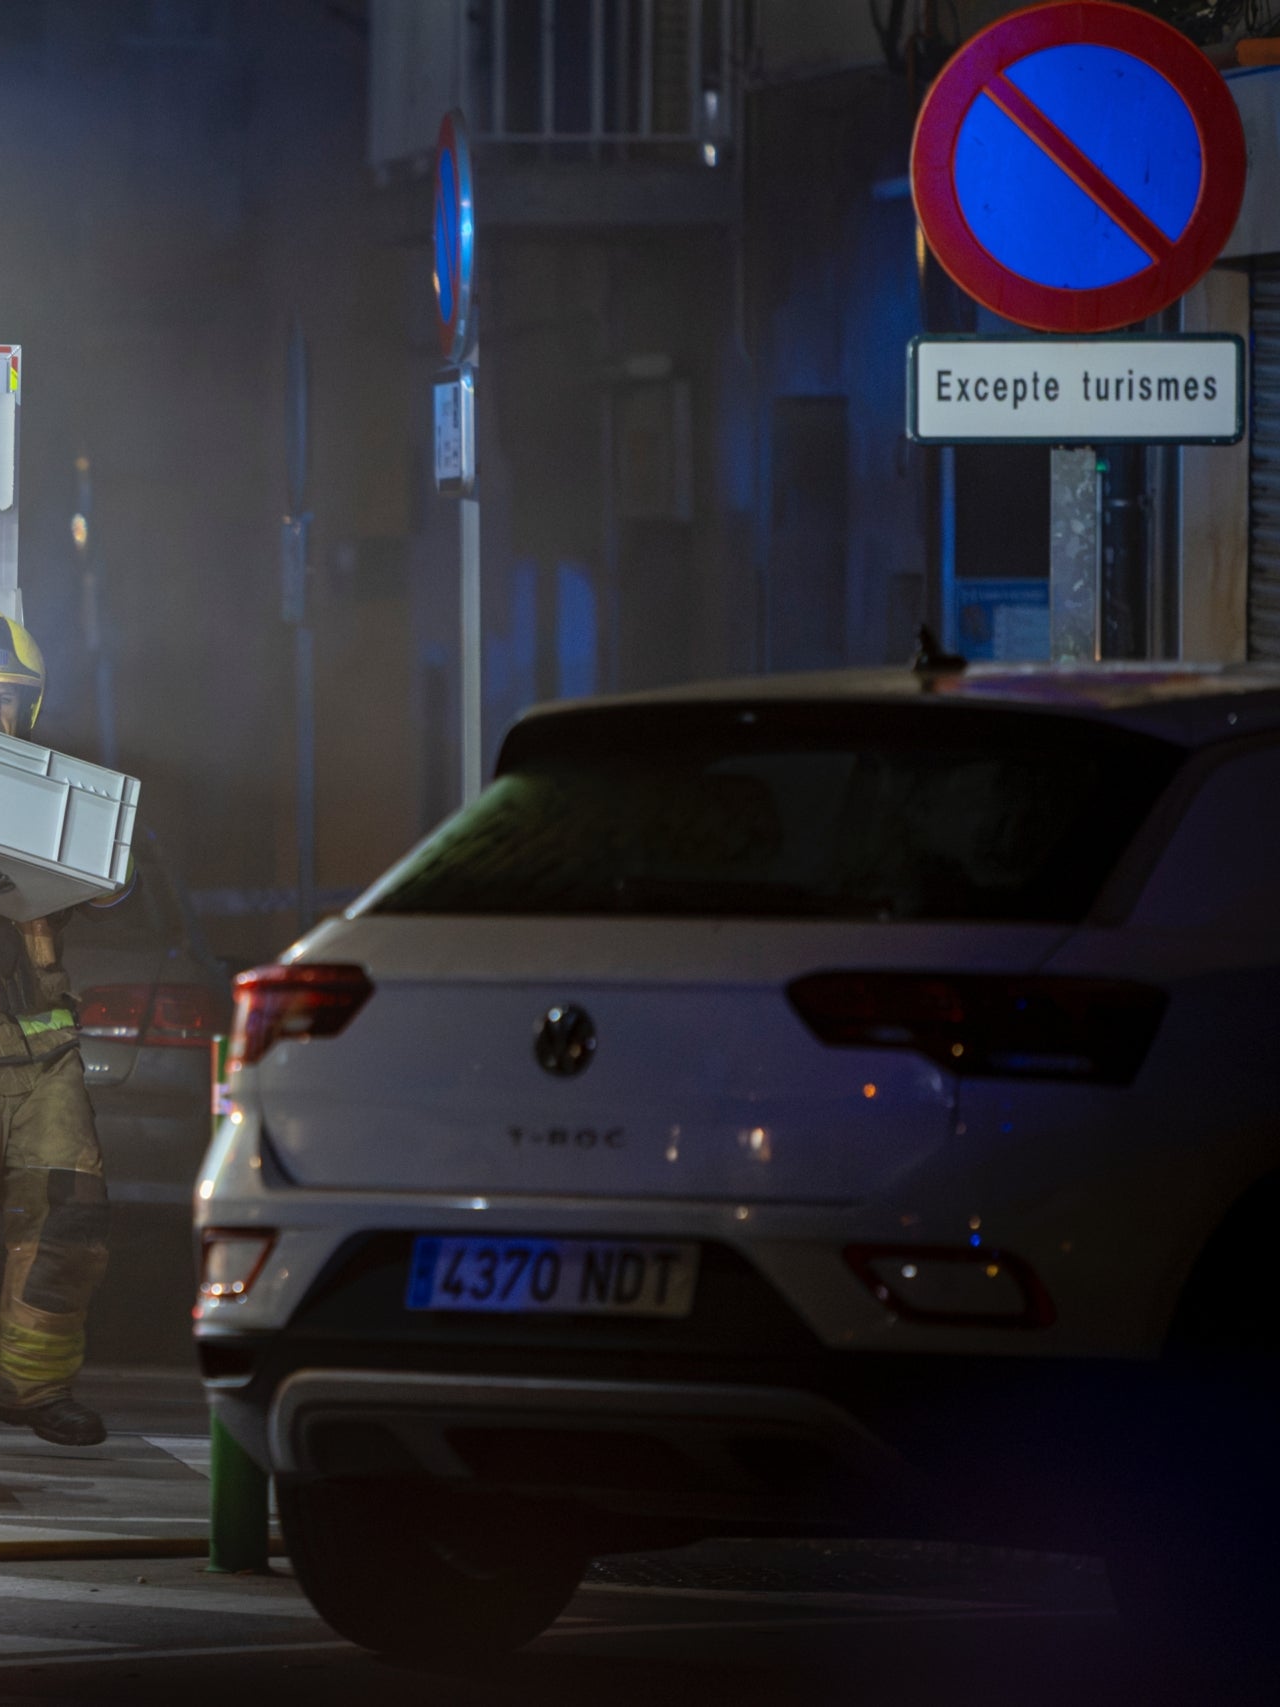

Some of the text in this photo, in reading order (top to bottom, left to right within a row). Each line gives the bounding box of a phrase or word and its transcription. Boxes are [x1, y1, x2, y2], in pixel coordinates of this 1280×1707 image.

[936, 369, 1218, 410] Excepte turismes
[508, 1126, 625, 1148] T-ROC
[442, 1247, 678, 1305] 4370 NDT
